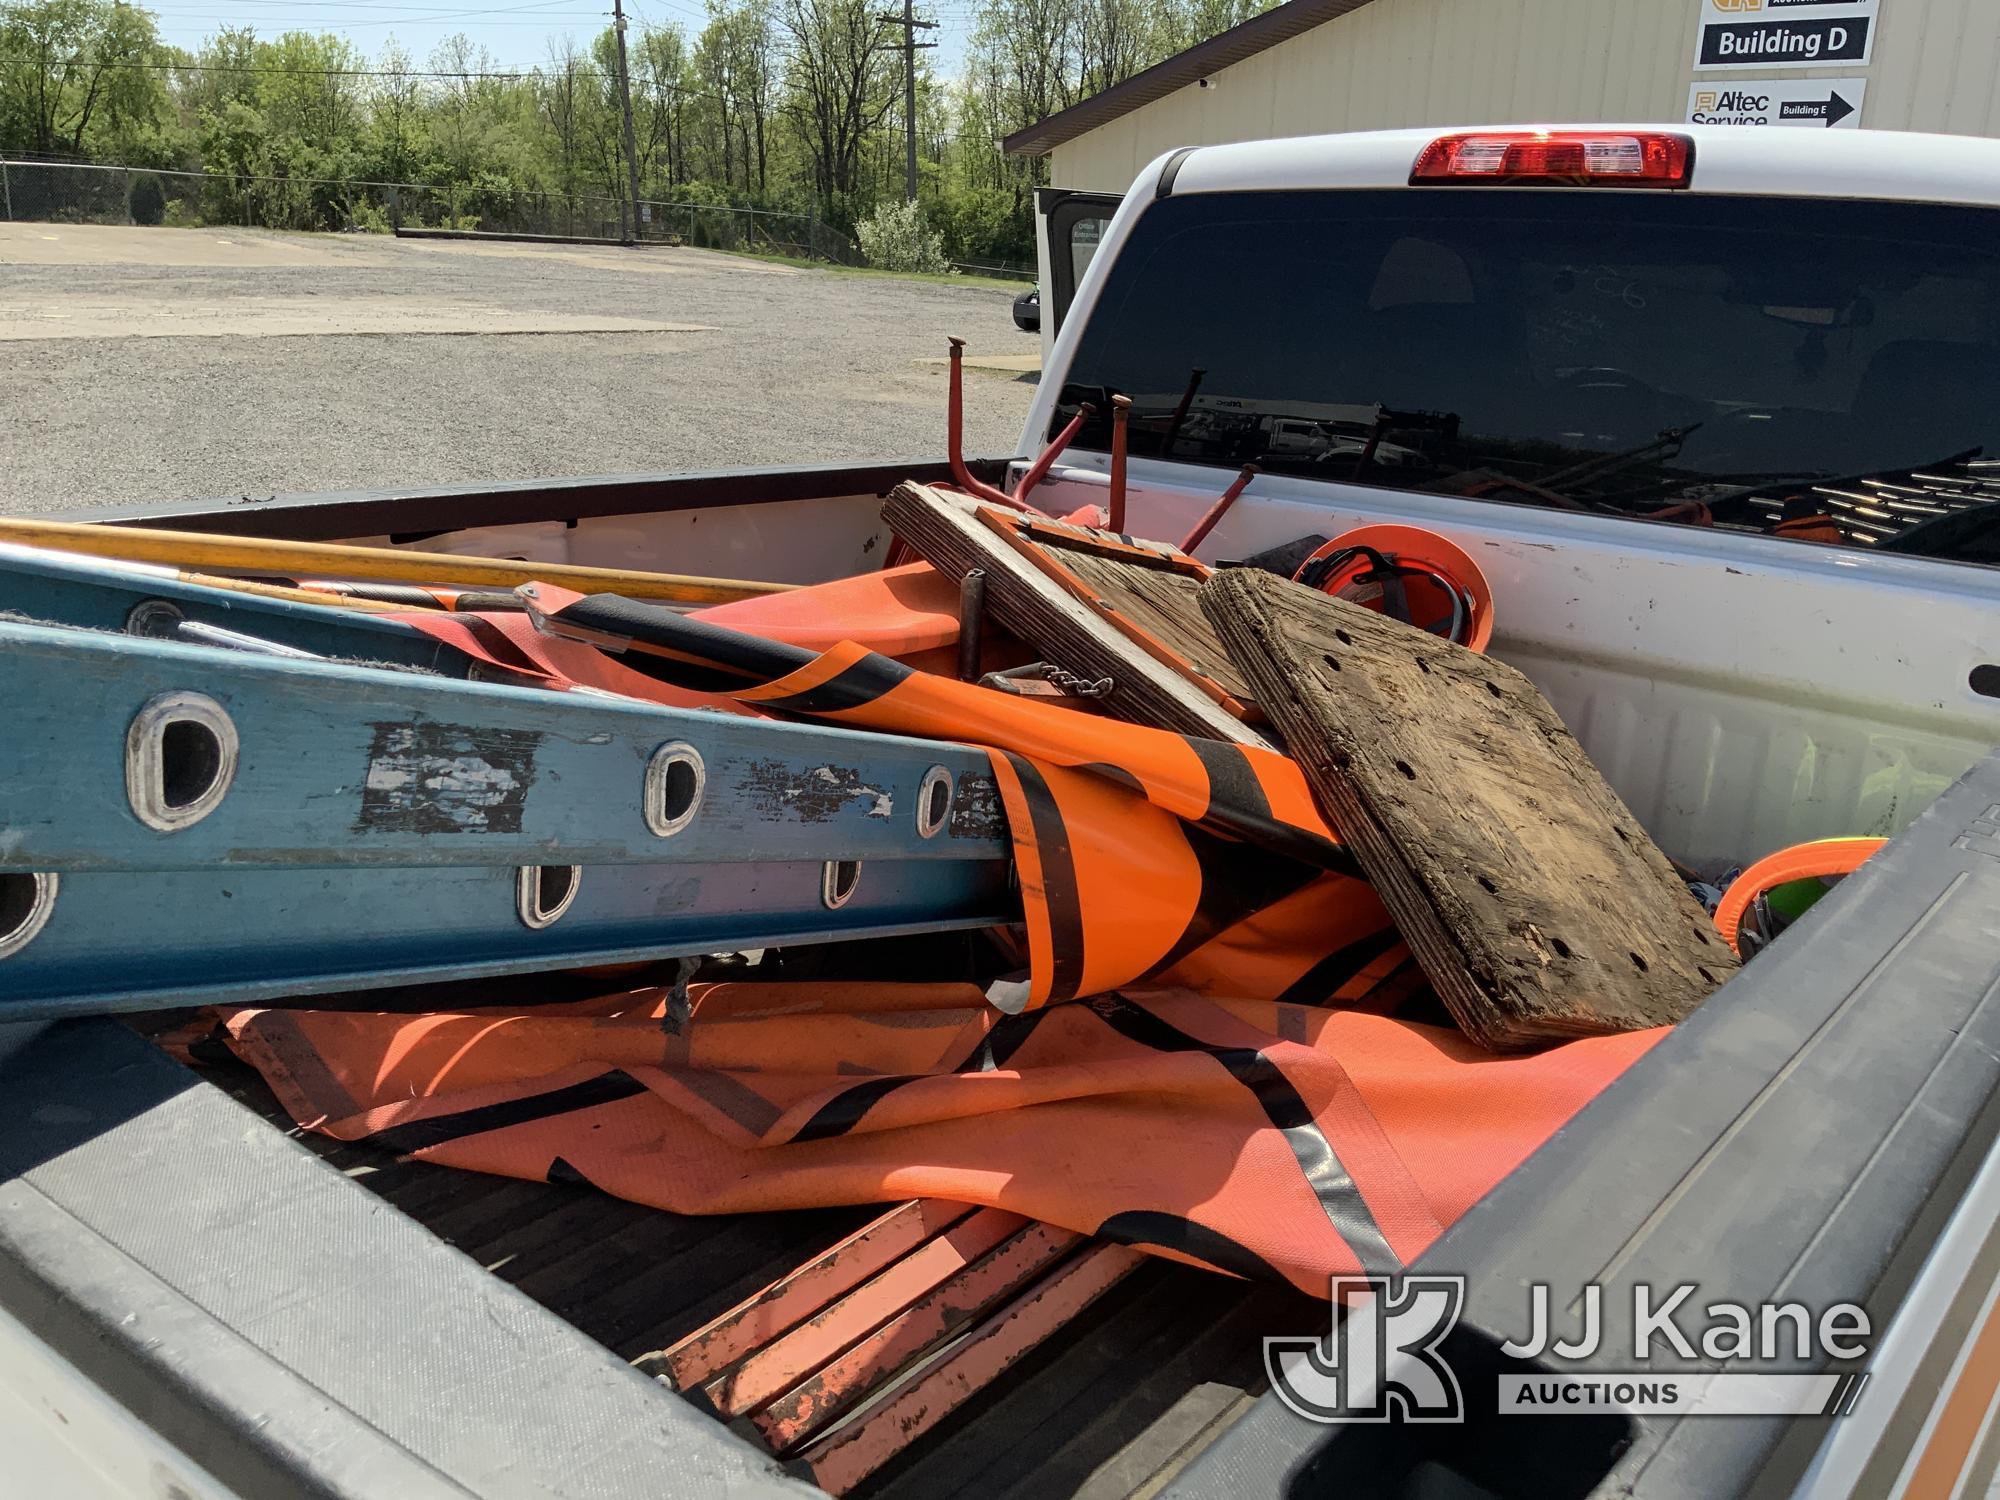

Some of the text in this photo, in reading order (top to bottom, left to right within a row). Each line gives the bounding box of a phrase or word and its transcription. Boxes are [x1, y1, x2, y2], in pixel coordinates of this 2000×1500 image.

[1719, 27, 1848, 57] Building D
[1717, 91, 1769, 112] Altec
[1783, 105, 1827, 116] Building E
